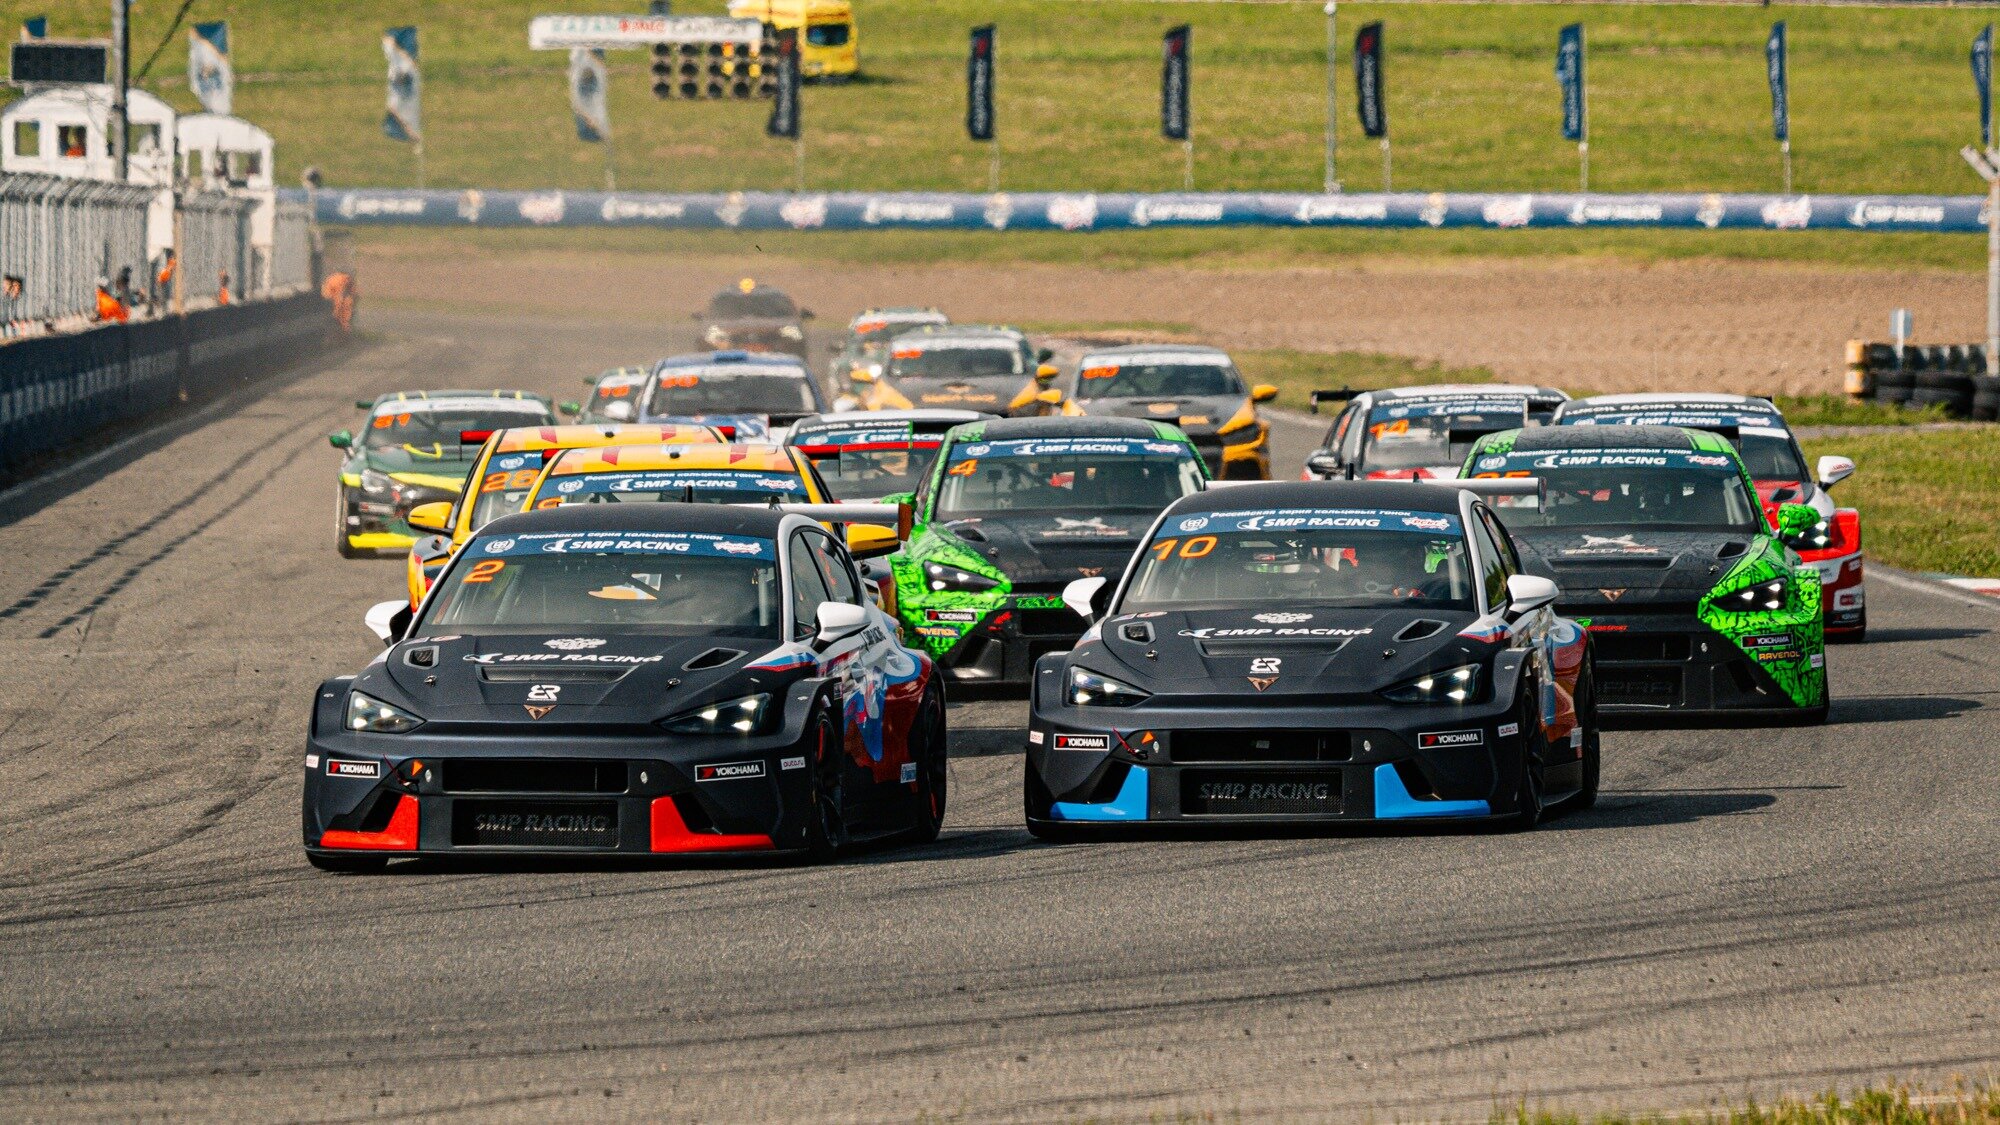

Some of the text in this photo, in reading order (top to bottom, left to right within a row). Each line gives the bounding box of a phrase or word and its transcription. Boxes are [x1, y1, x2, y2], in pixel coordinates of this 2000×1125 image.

[1369, 419, 1409, 440] 14
[1036, 444, 1128, 453] SMP RACING
[1560, 456, 1667, 466] SMP RACING
[949, 459, 978, 478] 4
[482, 469, 540, 493] 28
[633, 480, 738, 489] SMP RACING
[1210, 510, 1276, 518] Российская
[1263, 518, 1381, 527] SMP RACING
[518, 532, 585, 540] Российская
[569, 540, 690, 551] SMP RACING
[1152, 535, 1218, 561] 10
[463, 559, 506, 584] 2
[1214, 628, 1374, 637] SMP RACING
[1757, 635, 1789, 645] YOKOHAMA
[499, 653, 664, 663] SMP RACING
[1758, 650, 1800, 661] RAVENOL
[1067, 738, 1104, 748] YOKOHAMA
[1437, 733, 1479, 744] YOKOHAMA
[339, 764, 375, 775] YOKOHAMA
[715, 764, 760, 777] YOKOHAMA
[1199, 783, 1328, 800] SMP RACING
[474, 814, 609, 832] SMP RACING
